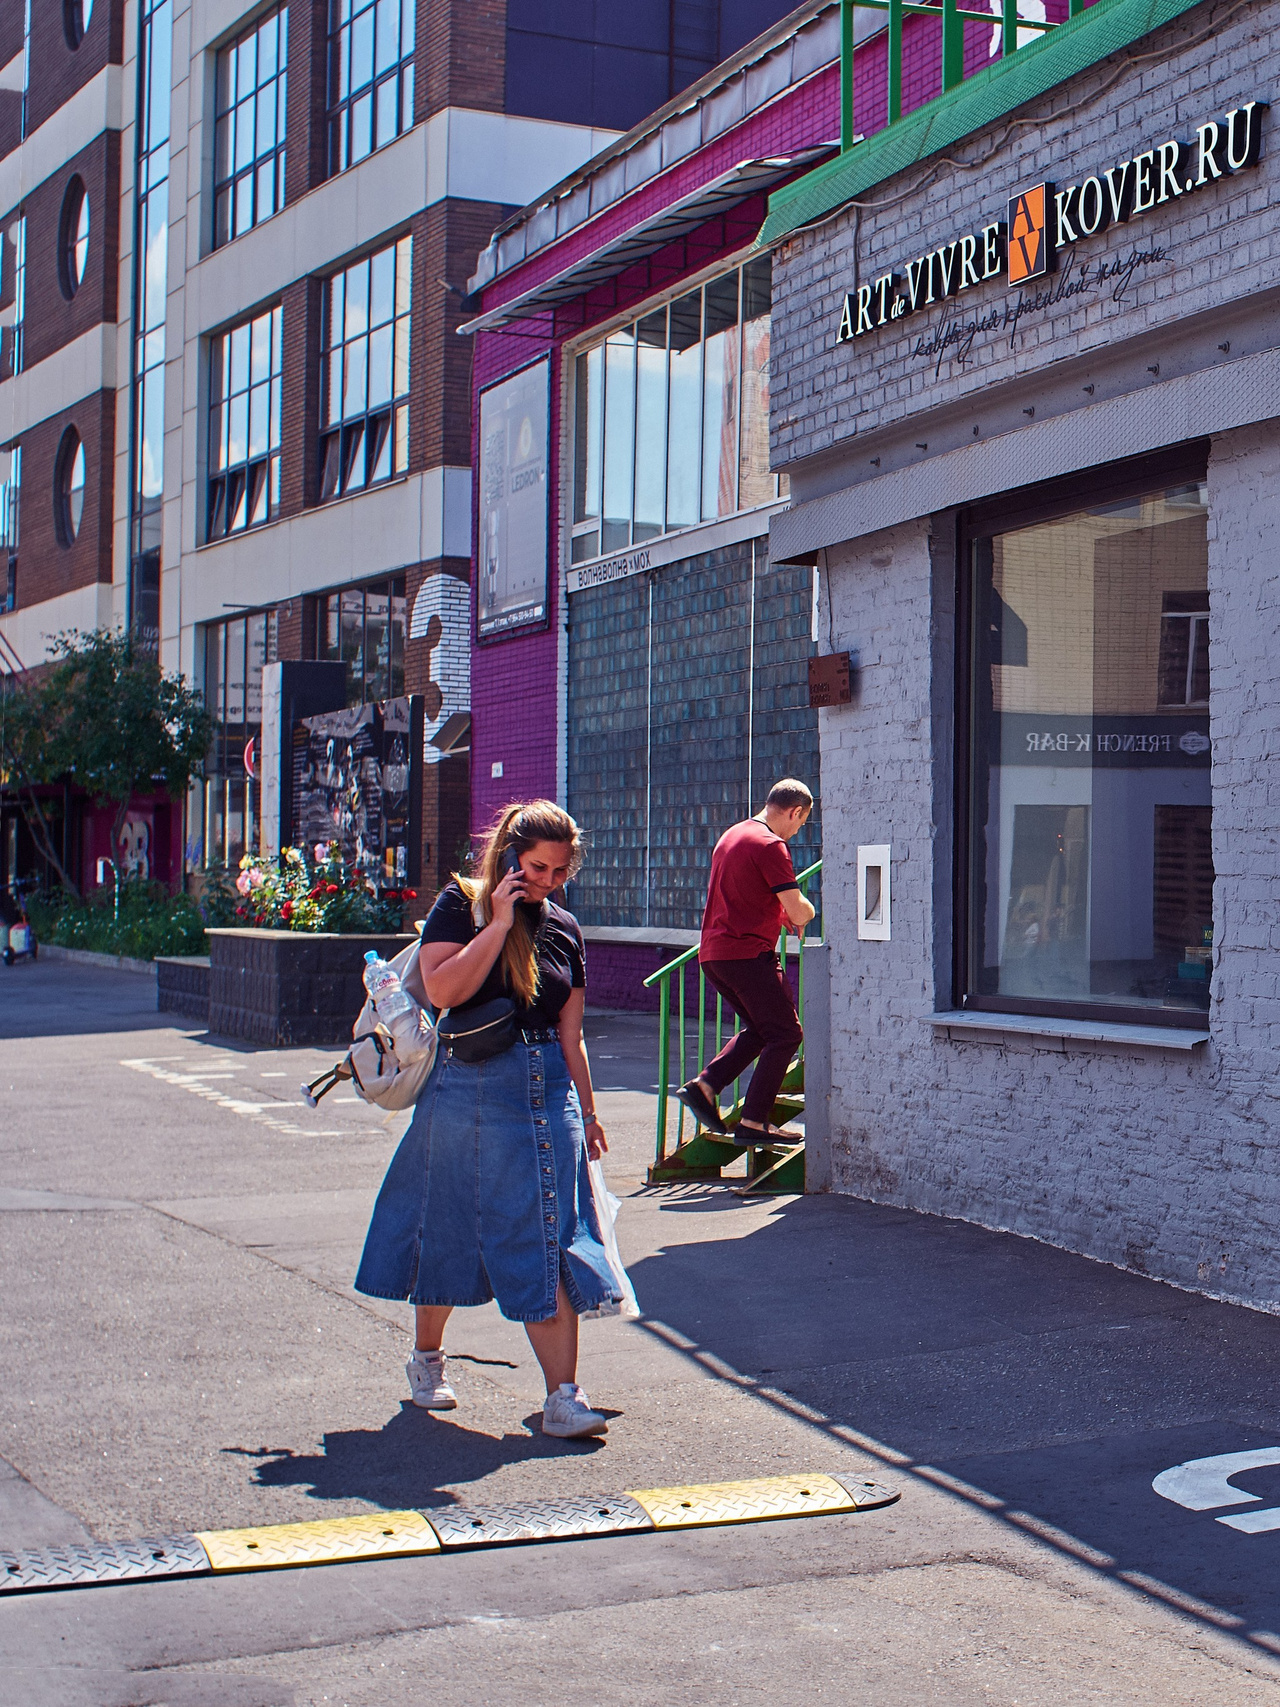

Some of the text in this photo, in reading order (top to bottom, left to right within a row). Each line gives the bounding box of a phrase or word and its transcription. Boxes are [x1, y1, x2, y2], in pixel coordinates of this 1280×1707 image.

[836, 101, 1256, 343] ART de VIVRE KOVER.RU
[511, 465, 541, 494] LEDRON
